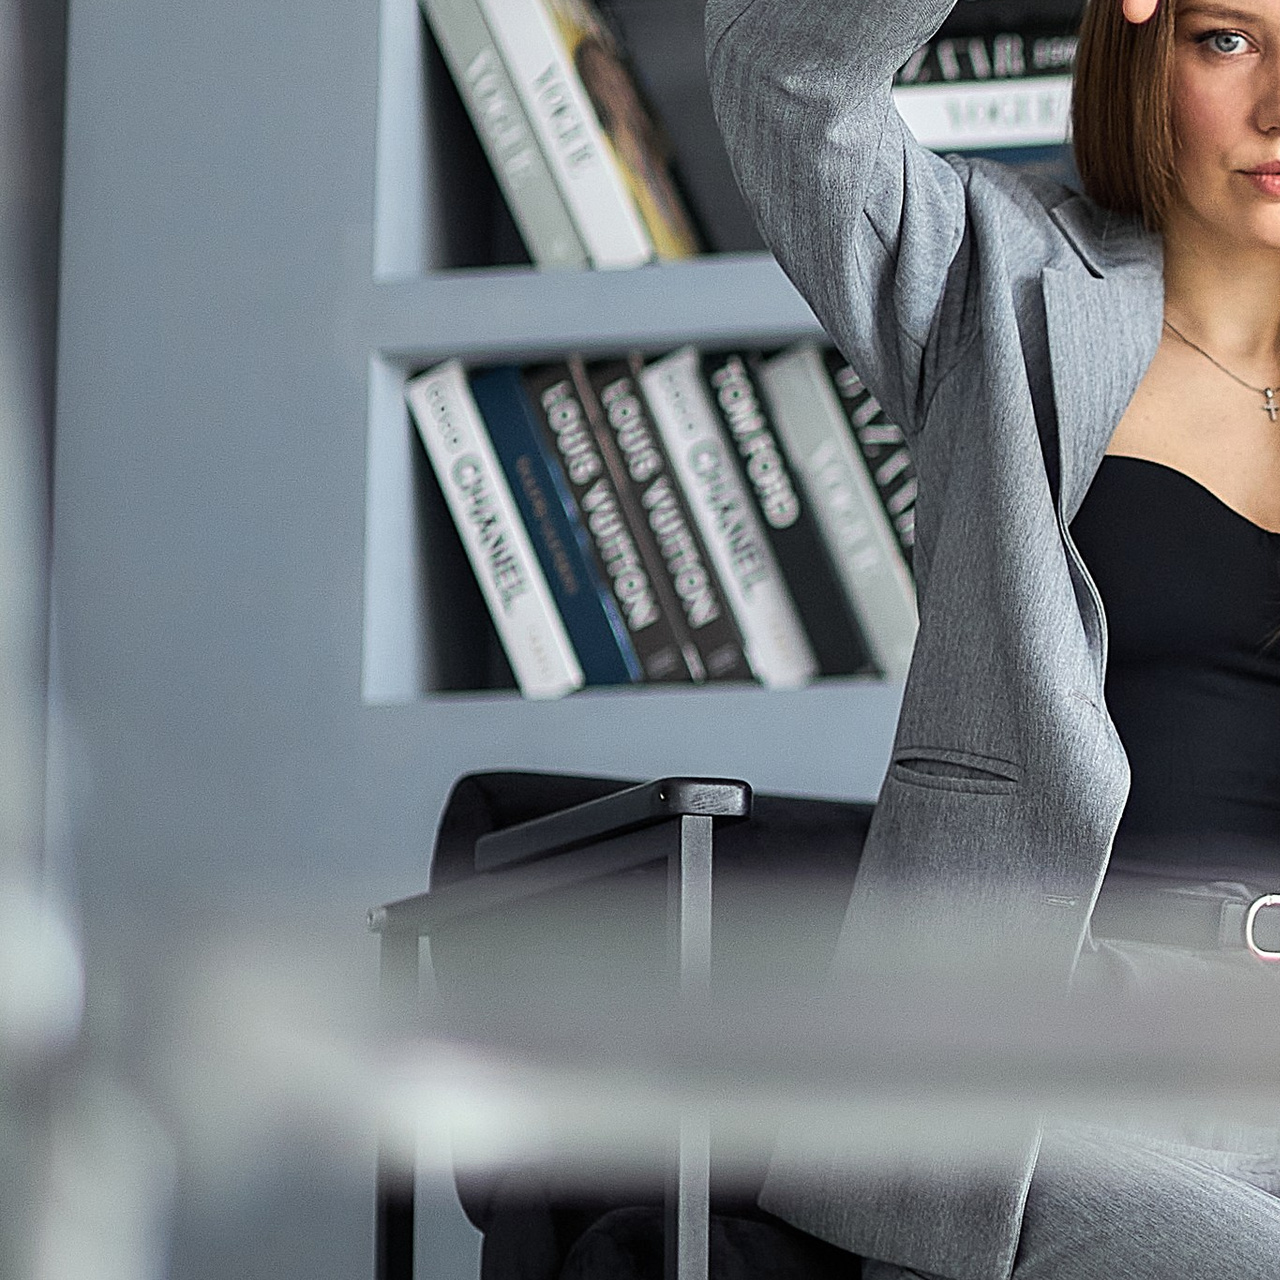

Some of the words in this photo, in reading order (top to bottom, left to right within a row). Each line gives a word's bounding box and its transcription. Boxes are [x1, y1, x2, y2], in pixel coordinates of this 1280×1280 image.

[466, 48, 537, 172] VOGUE
[532, 60, 594, 166] VOGUE
[541, 379, 601, 486] LOUIS
[582, 477, 660, 632] VUITTON
[601, 376, 661, 483] LOUIS
[642, 475, 721, 630] VUITTON
[687, 437, 771, 601] CHANEL
[712, 355, 766, 440] TOM
[739, 428, 801, 530] FORD
[451, 453, 531, 613] CHANEL
